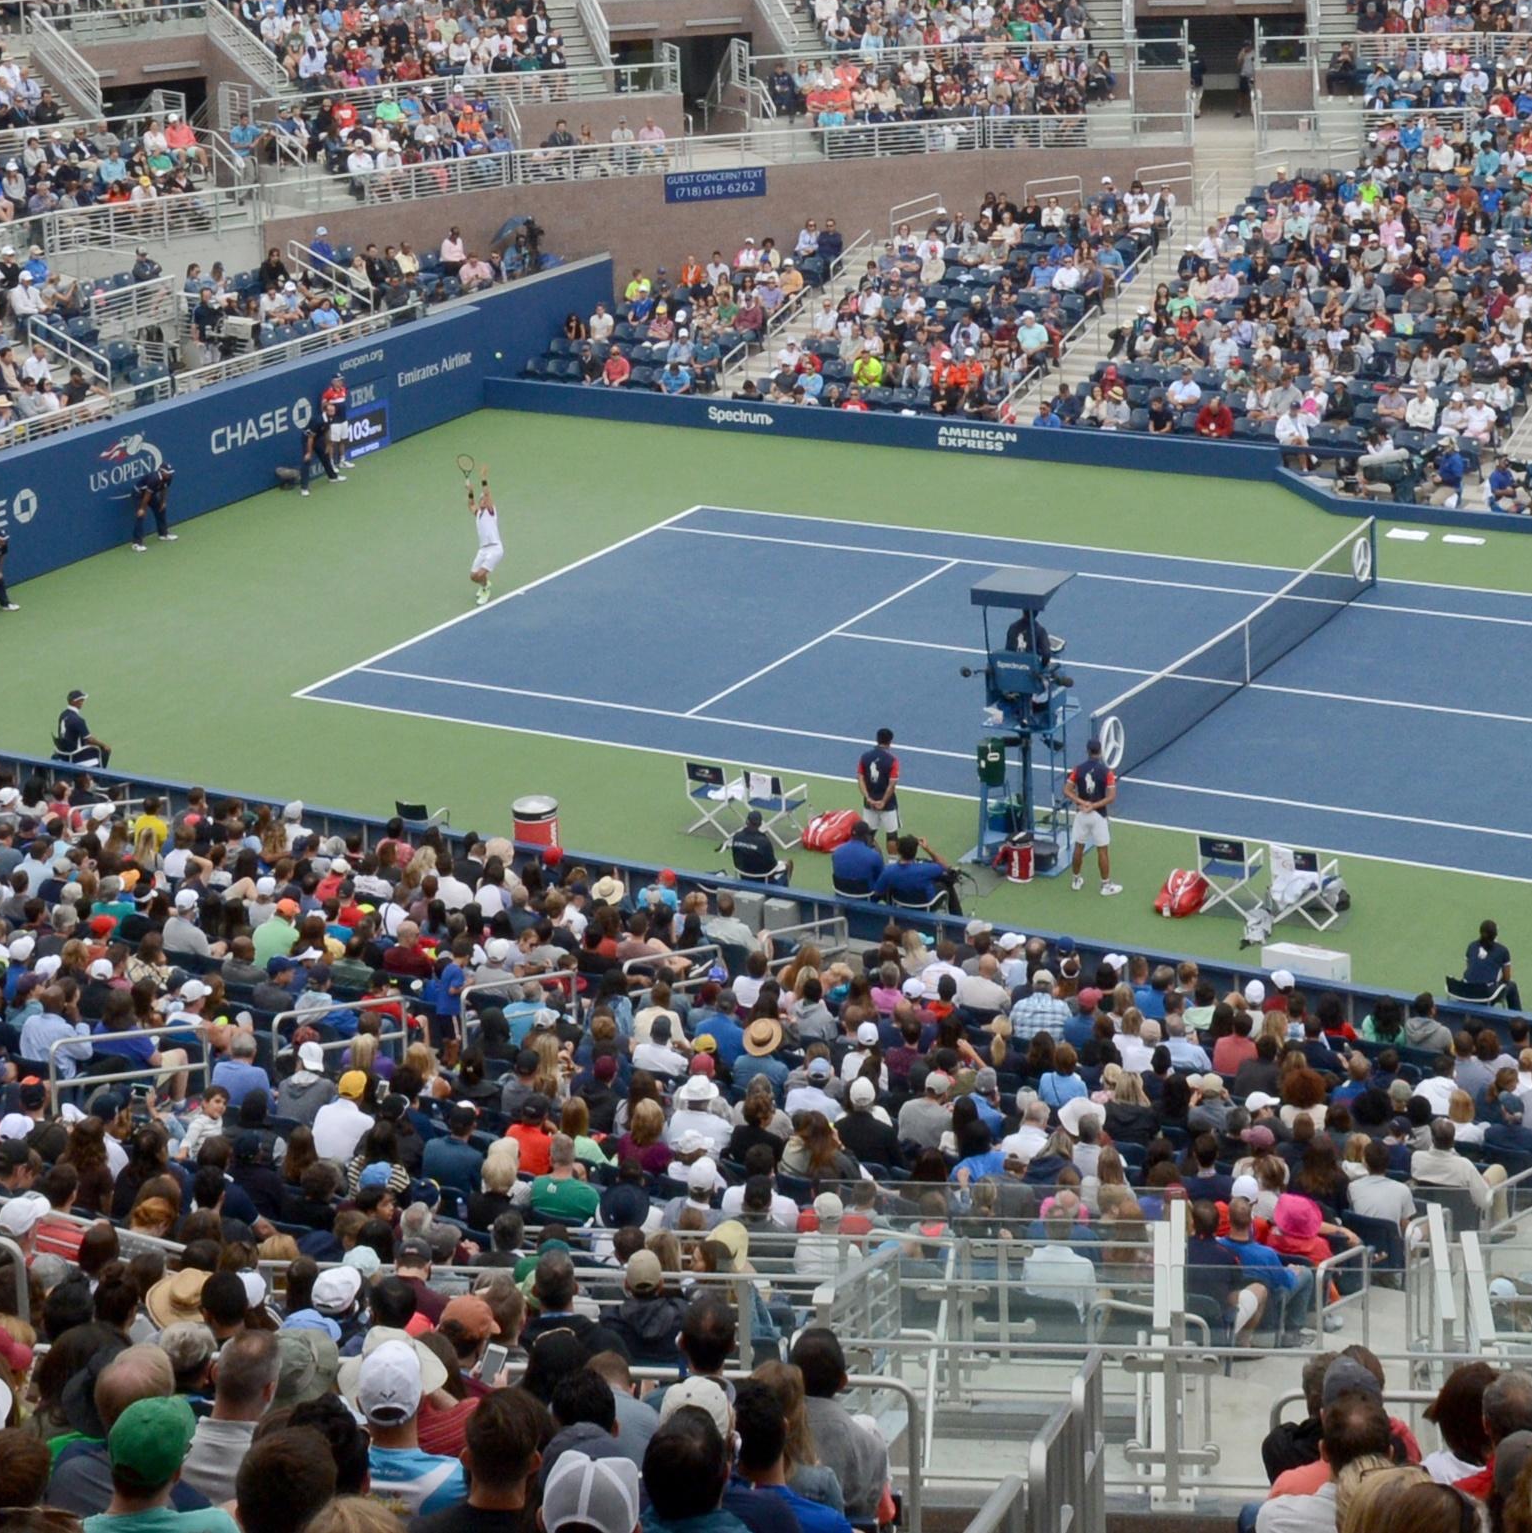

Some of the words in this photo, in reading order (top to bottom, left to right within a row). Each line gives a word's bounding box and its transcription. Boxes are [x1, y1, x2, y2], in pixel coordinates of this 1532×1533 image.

[667, 174, 695, 185] GUEST
[697, 171, 741, 183] CONCERN?
[743, 168, 763, 179] TEXT
[675, 186, 702, 199] (718)
[339, 348, 384, 371] usopen.org
[397, 365, 439, 387] Emirates
[441, 351, 472, 370] Airline
[350, 384, 375, 408] IBM
[708, 406, 769, 426] Spectrum
[211, 406, 288, 455] CHASE
[348, 419, 370, 442] 103
[938, 426, 1017, 443] AMERICAN
[938, 436, 1005, 452] EXPRESS
[89, 471, 110, 492] US
[112, 455, 153, 485] OPEN
